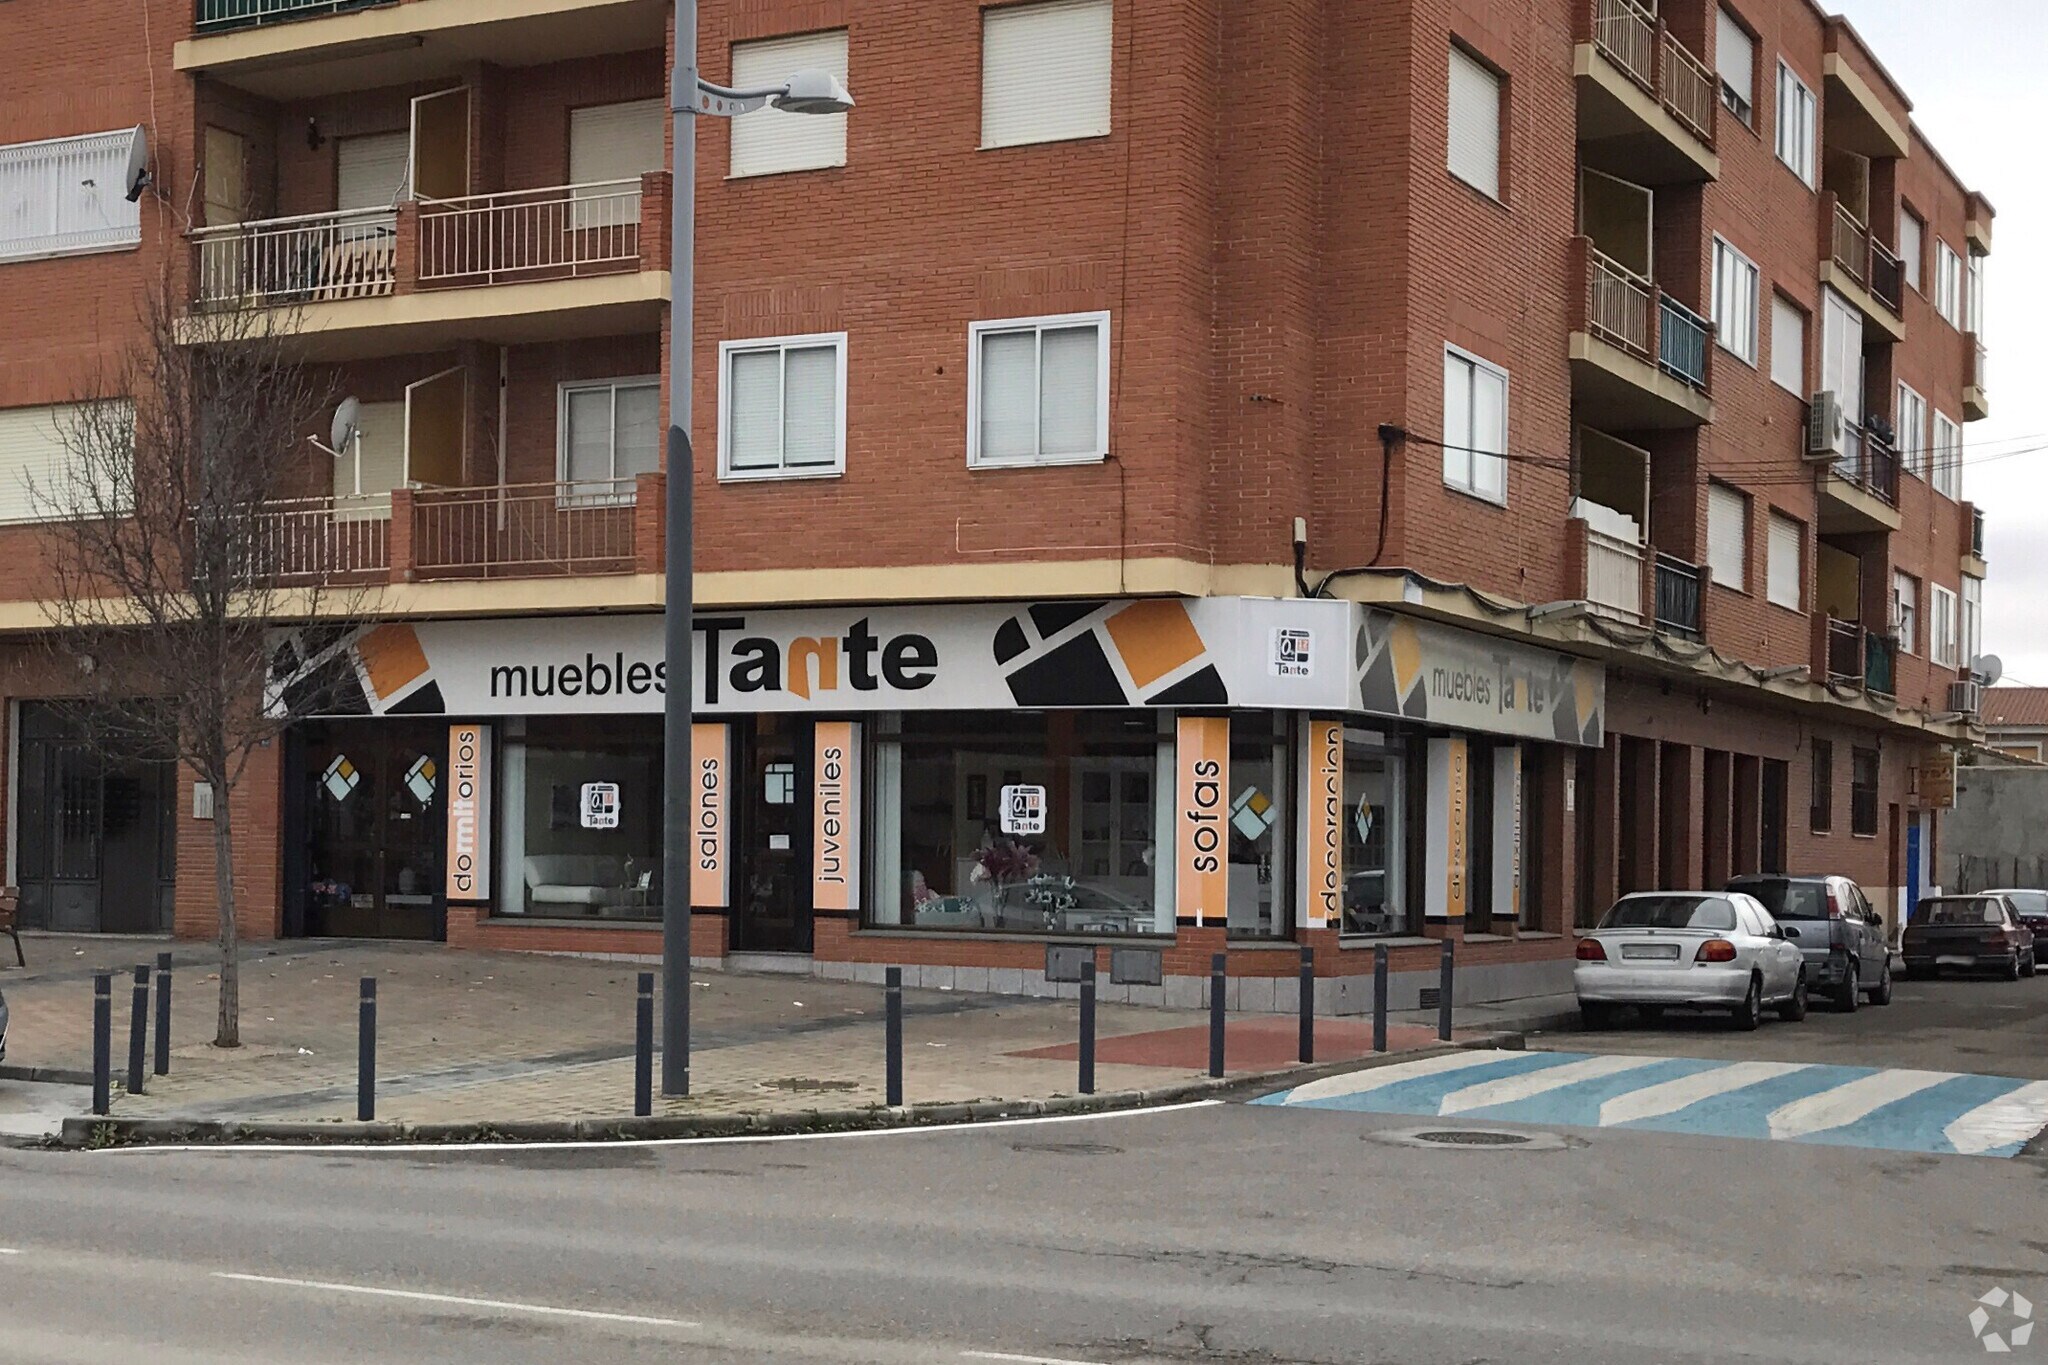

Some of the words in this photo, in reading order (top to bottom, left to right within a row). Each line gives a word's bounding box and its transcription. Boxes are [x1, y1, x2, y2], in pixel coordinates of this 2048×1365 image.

[692, 617, 938, 704] Tante
[1274, 662, 1309, 676] Tante
[1433, 667, 1491, 705] muebles
[586, 814, 614, 826] Tante
[697, 758, 718, 870] salones
[819, 748, 845, 883] juveniles
[1007, 819, 1040, 831] Tante
[1187, 760, 1220, 872] sofas
[1320, 728, 1338, 911] decoracion
